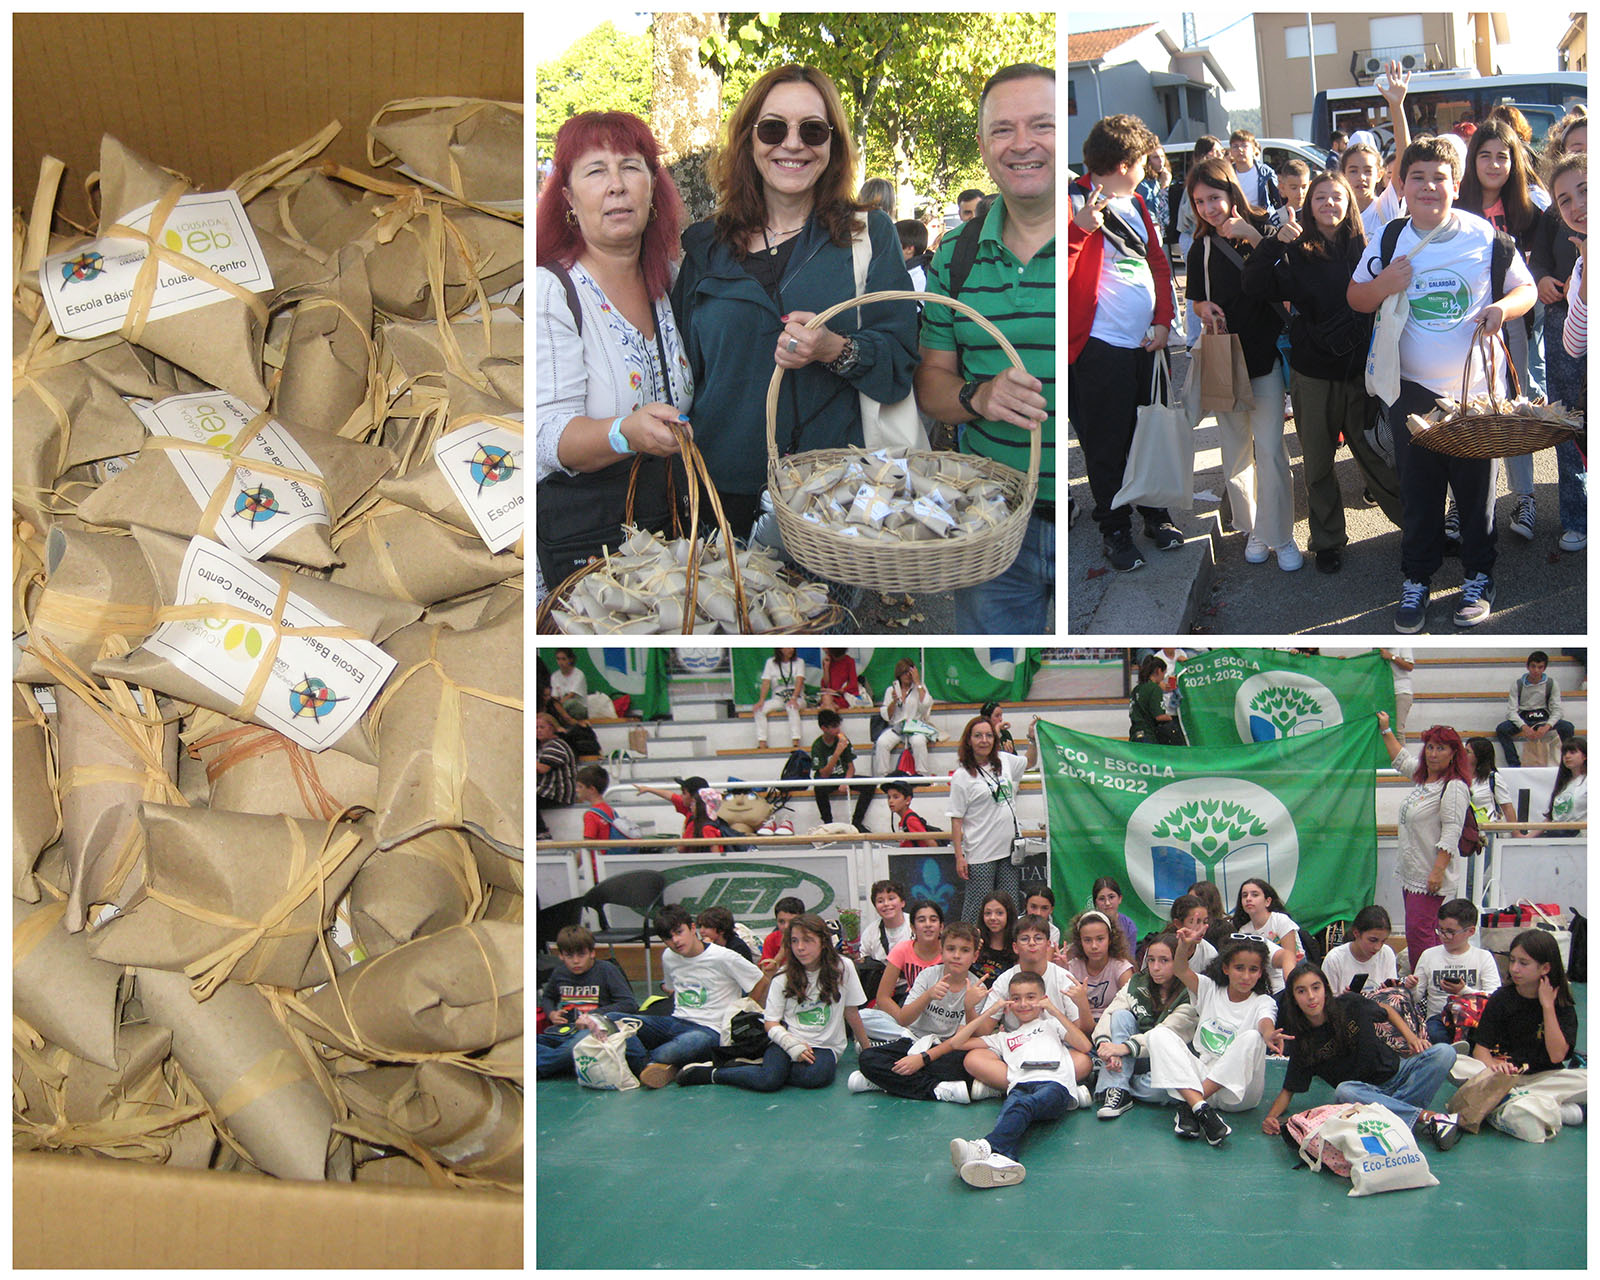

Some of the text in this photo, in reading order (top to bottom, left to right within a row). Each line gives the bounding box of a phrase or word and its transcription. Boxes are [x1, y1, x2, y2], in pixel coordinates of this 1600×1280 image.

[187, 229, 231, 253] eb
[66, 260, 247, 316] Escola Básic Lousa Centro
[264, 444, 275, 456] de
[290, 480, 314, 508] Escola
[487, 495, 524, 521] Escola
[197, 567, 233, 591] Centro
[234, 586, 273, 616] ousada
[301, 635, 331, 659] Básic
[331, 654, 365, 684] Escola
[1183, 663, 1204, 675] CO
[1214, 656, 1260, 671] ESCOLA
[1184, 669, 1244, 687] 2021-2022
[1058, 761, 1148, 794] 2021-2022
[1104, 757, 1175, 778] ESCOLA
[679, 877, 803, 914] JET
[1362, 1153, 1421, 1172] Eco-Escolas
